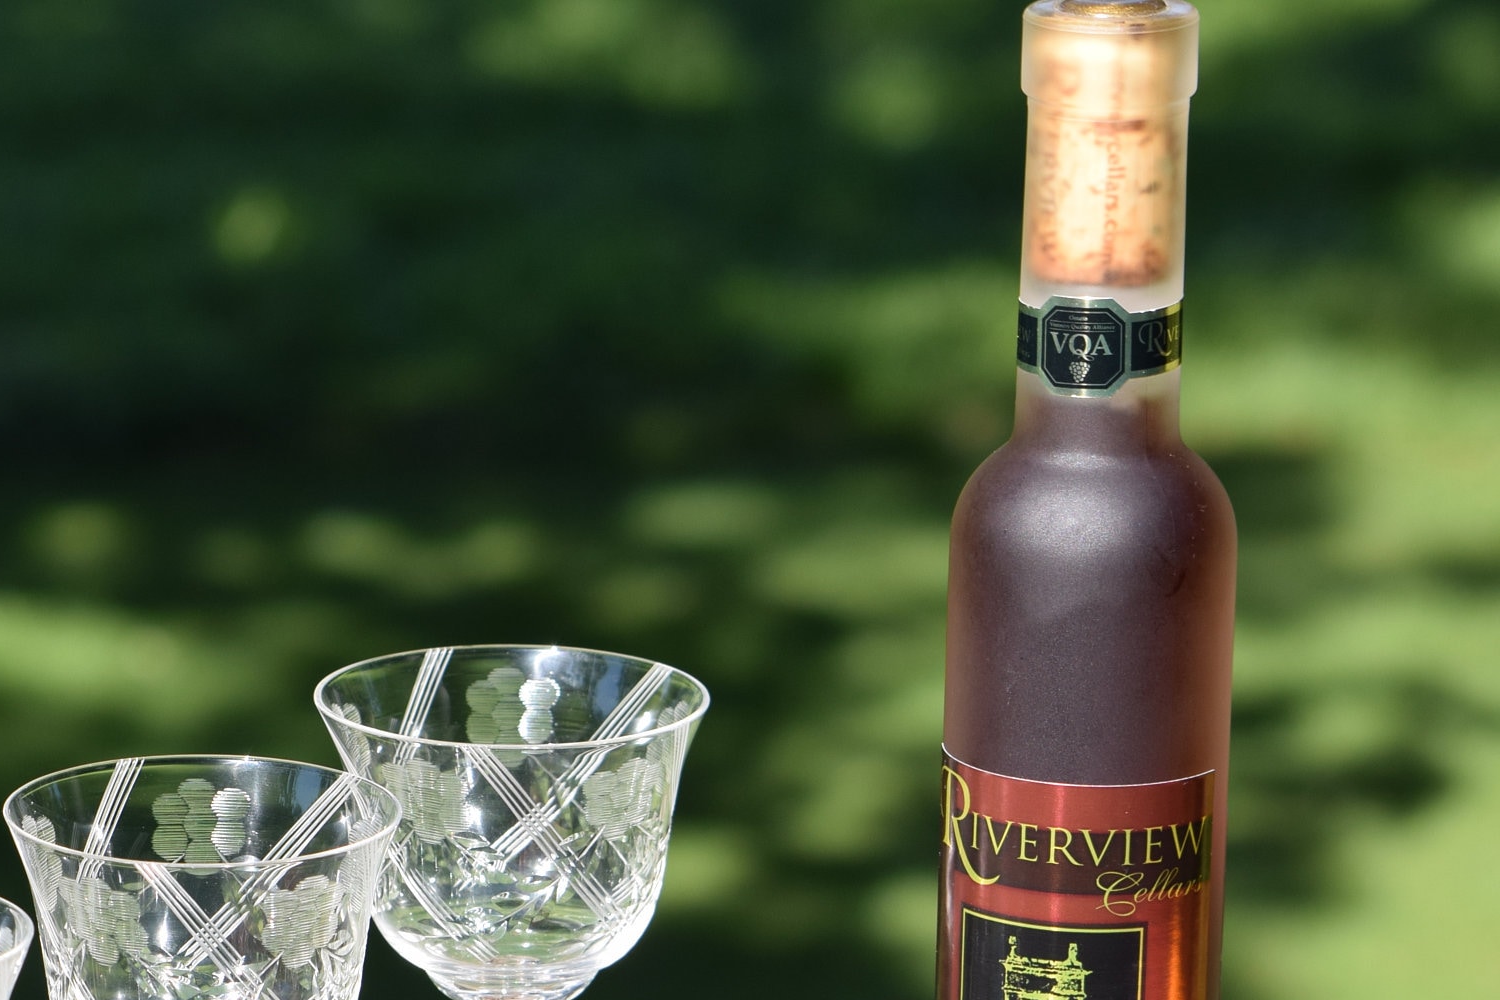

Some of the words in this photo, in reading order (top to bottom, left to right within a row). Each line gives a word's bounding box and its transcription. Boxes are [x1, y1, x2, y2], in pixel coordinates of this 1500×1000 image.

[1050, 331, 1113, 361] VQA
[941, 765, 1209, 885] RIVERVIEW
[1095, 867, 1205, 917] Cellars
